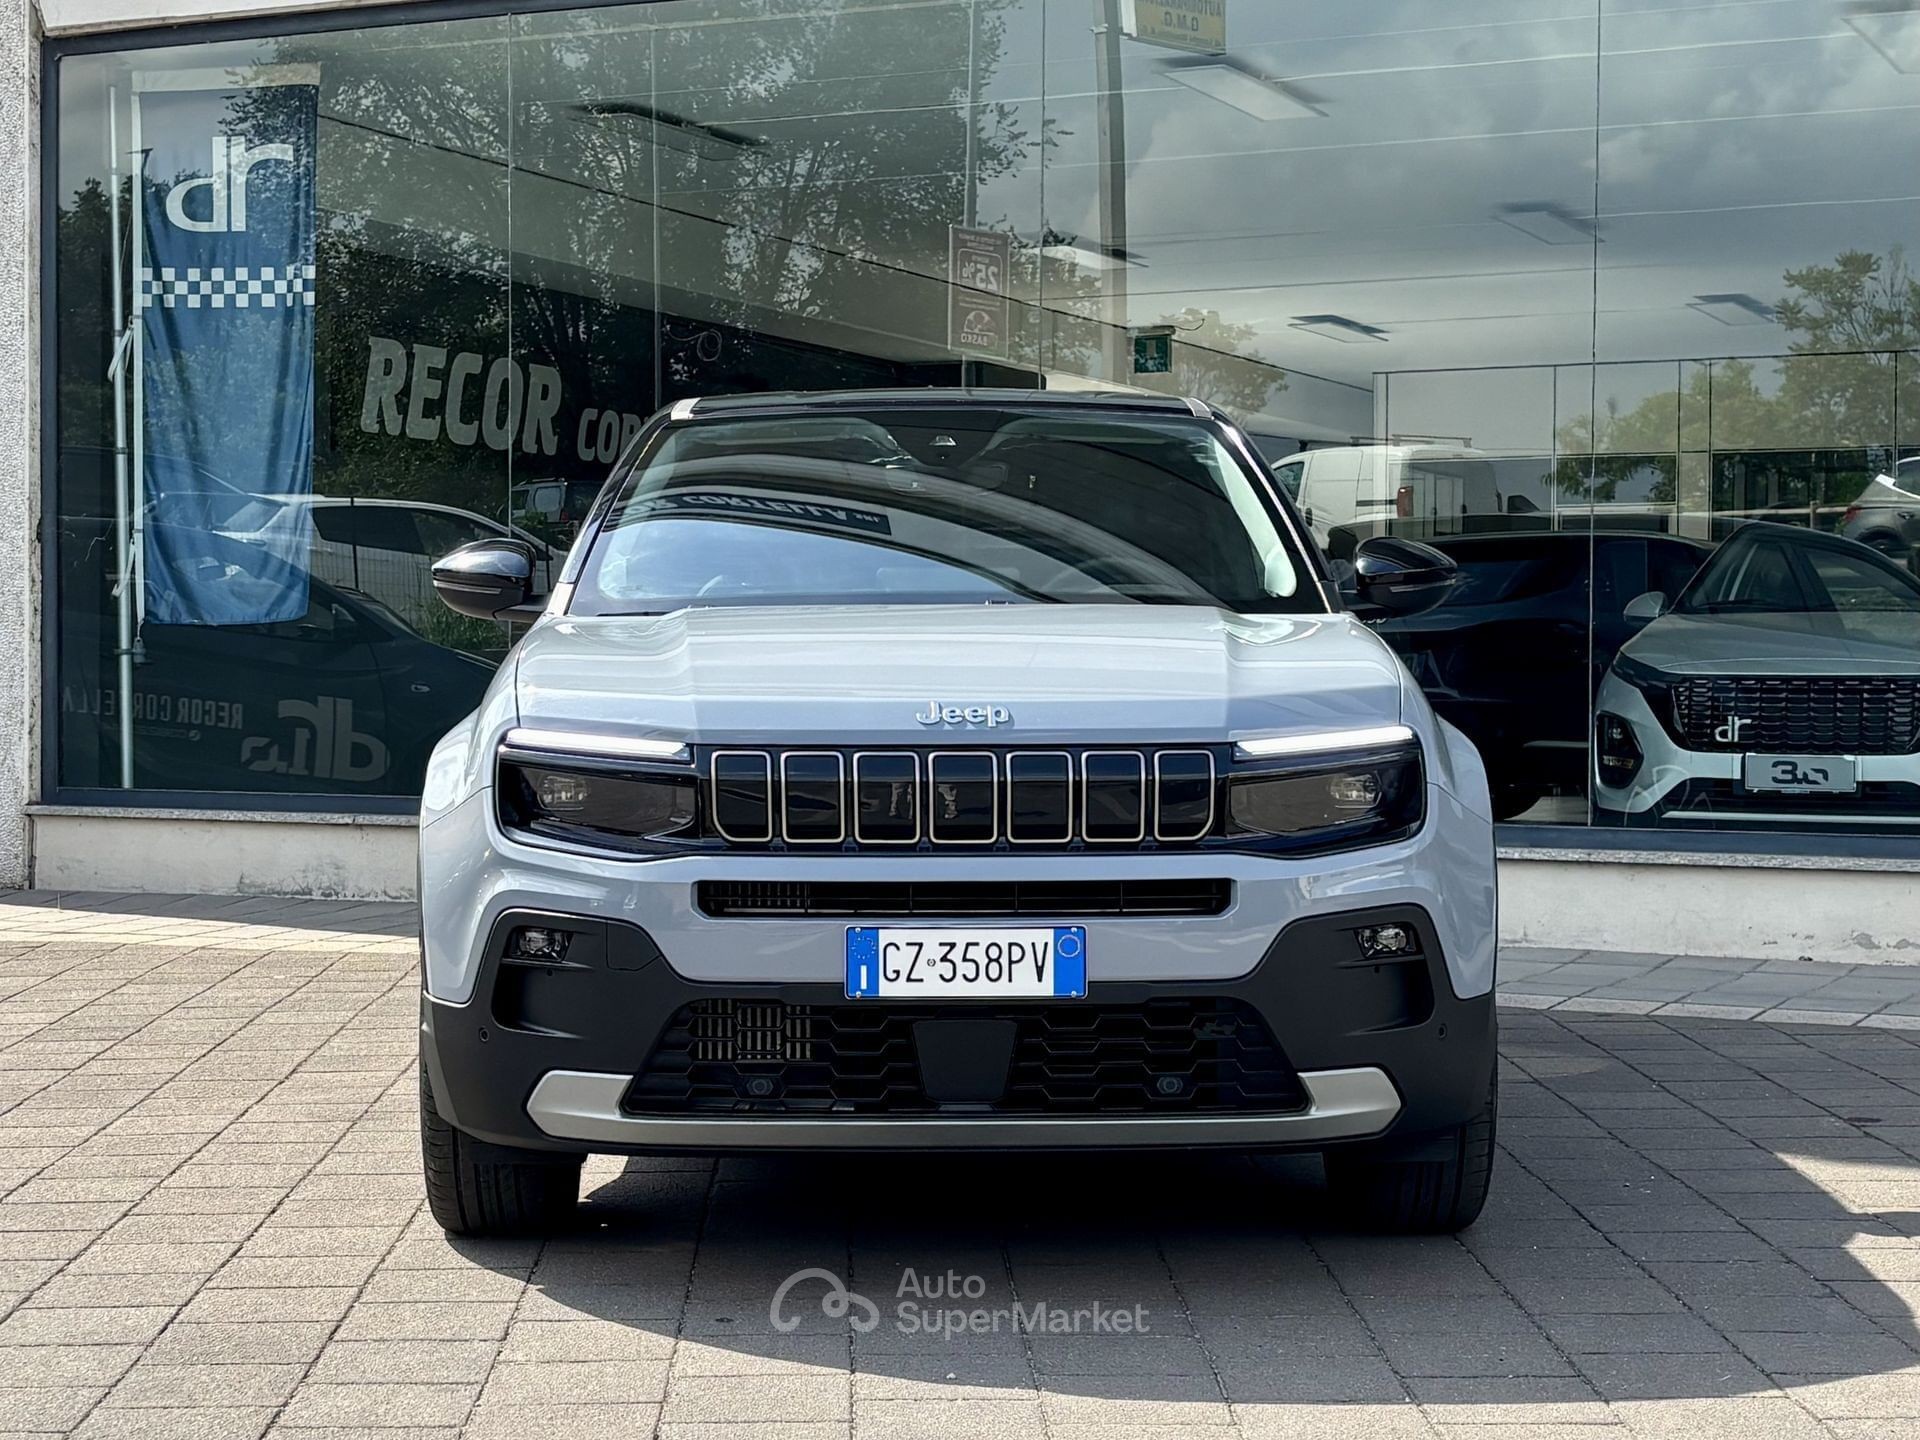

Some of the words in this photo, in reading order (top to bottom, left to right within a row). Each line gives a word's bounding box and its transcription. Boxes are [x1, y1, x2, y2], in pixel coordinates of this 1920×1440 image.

[166, 136, 293, 233] dr
[360, 335, 562, 457] RECOR
[577, 407, 649, 465] COR
[915, 699, 1011, 728] Jeep
[1714, 715, 1752, 743] dr
